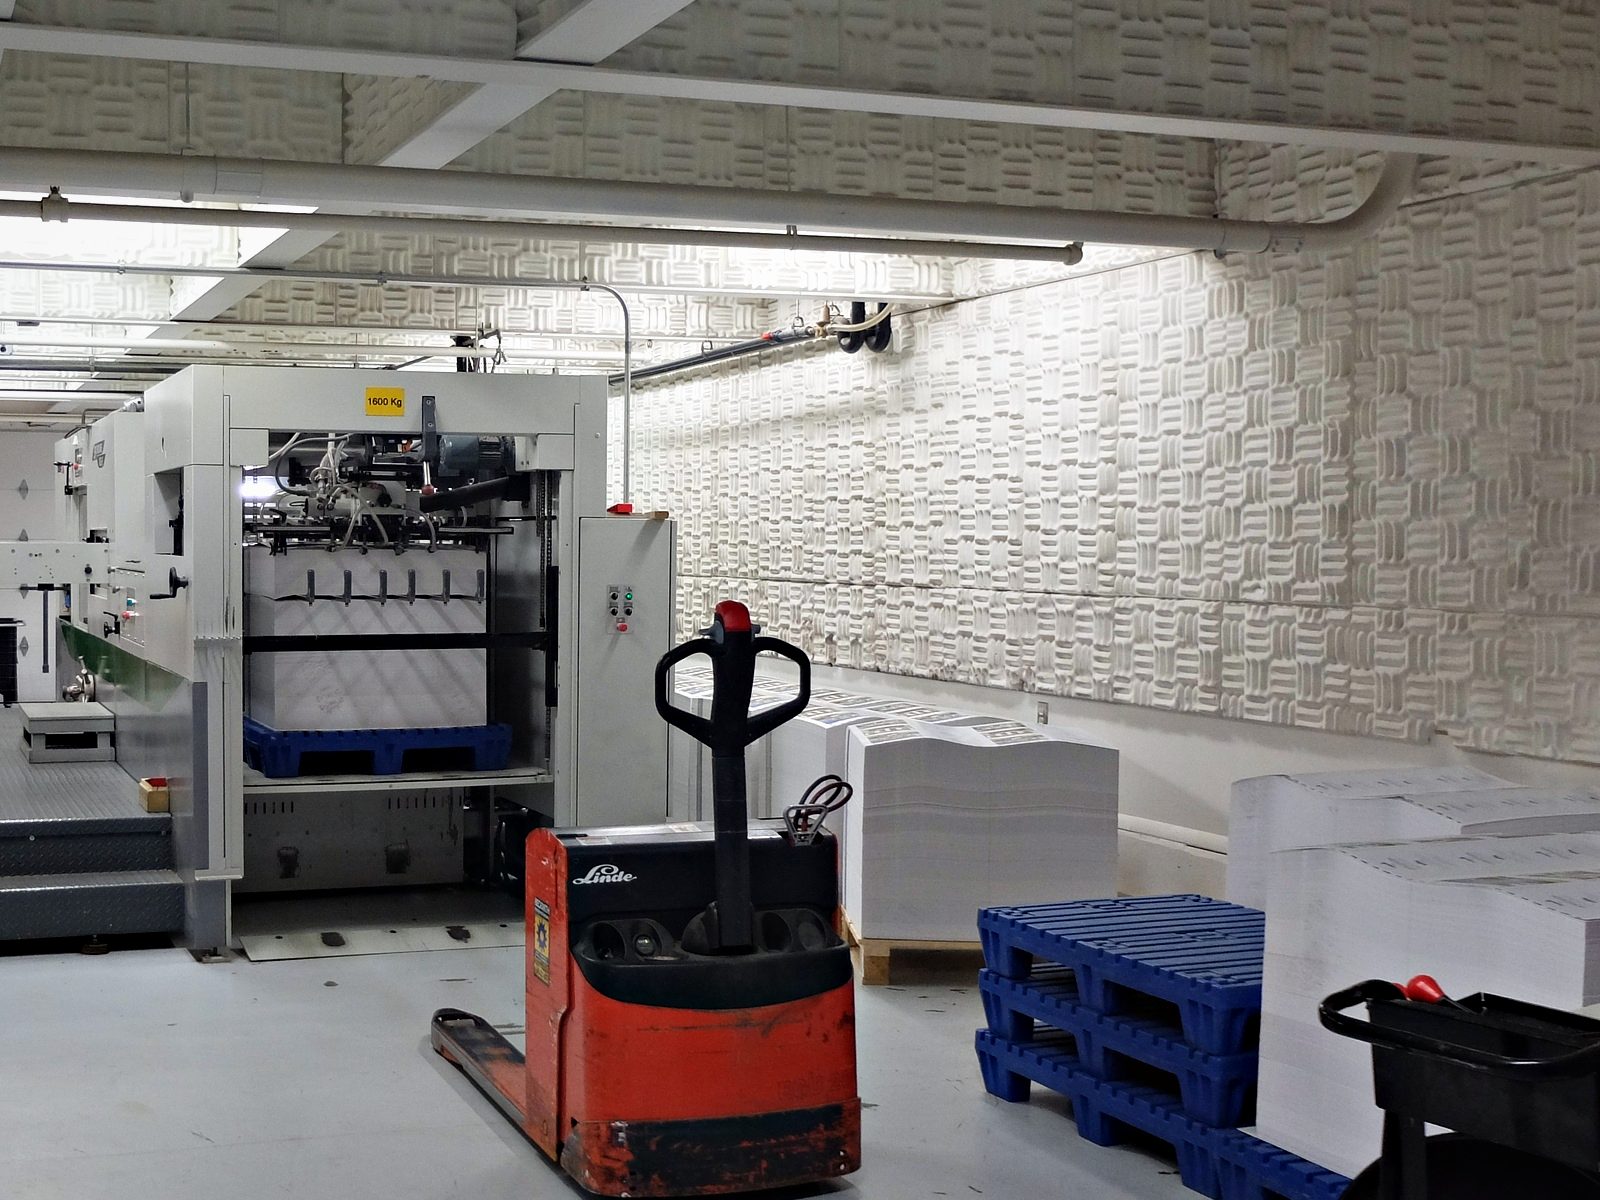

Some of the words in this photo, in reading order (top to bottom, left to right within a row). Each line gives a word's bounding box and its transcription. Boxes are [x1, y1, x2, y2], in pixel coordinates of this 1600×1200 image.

[367, 397, 389, 406] 1600
[390, 397, 403, 409] Kg
[572, 863, 637, 885] Linde
